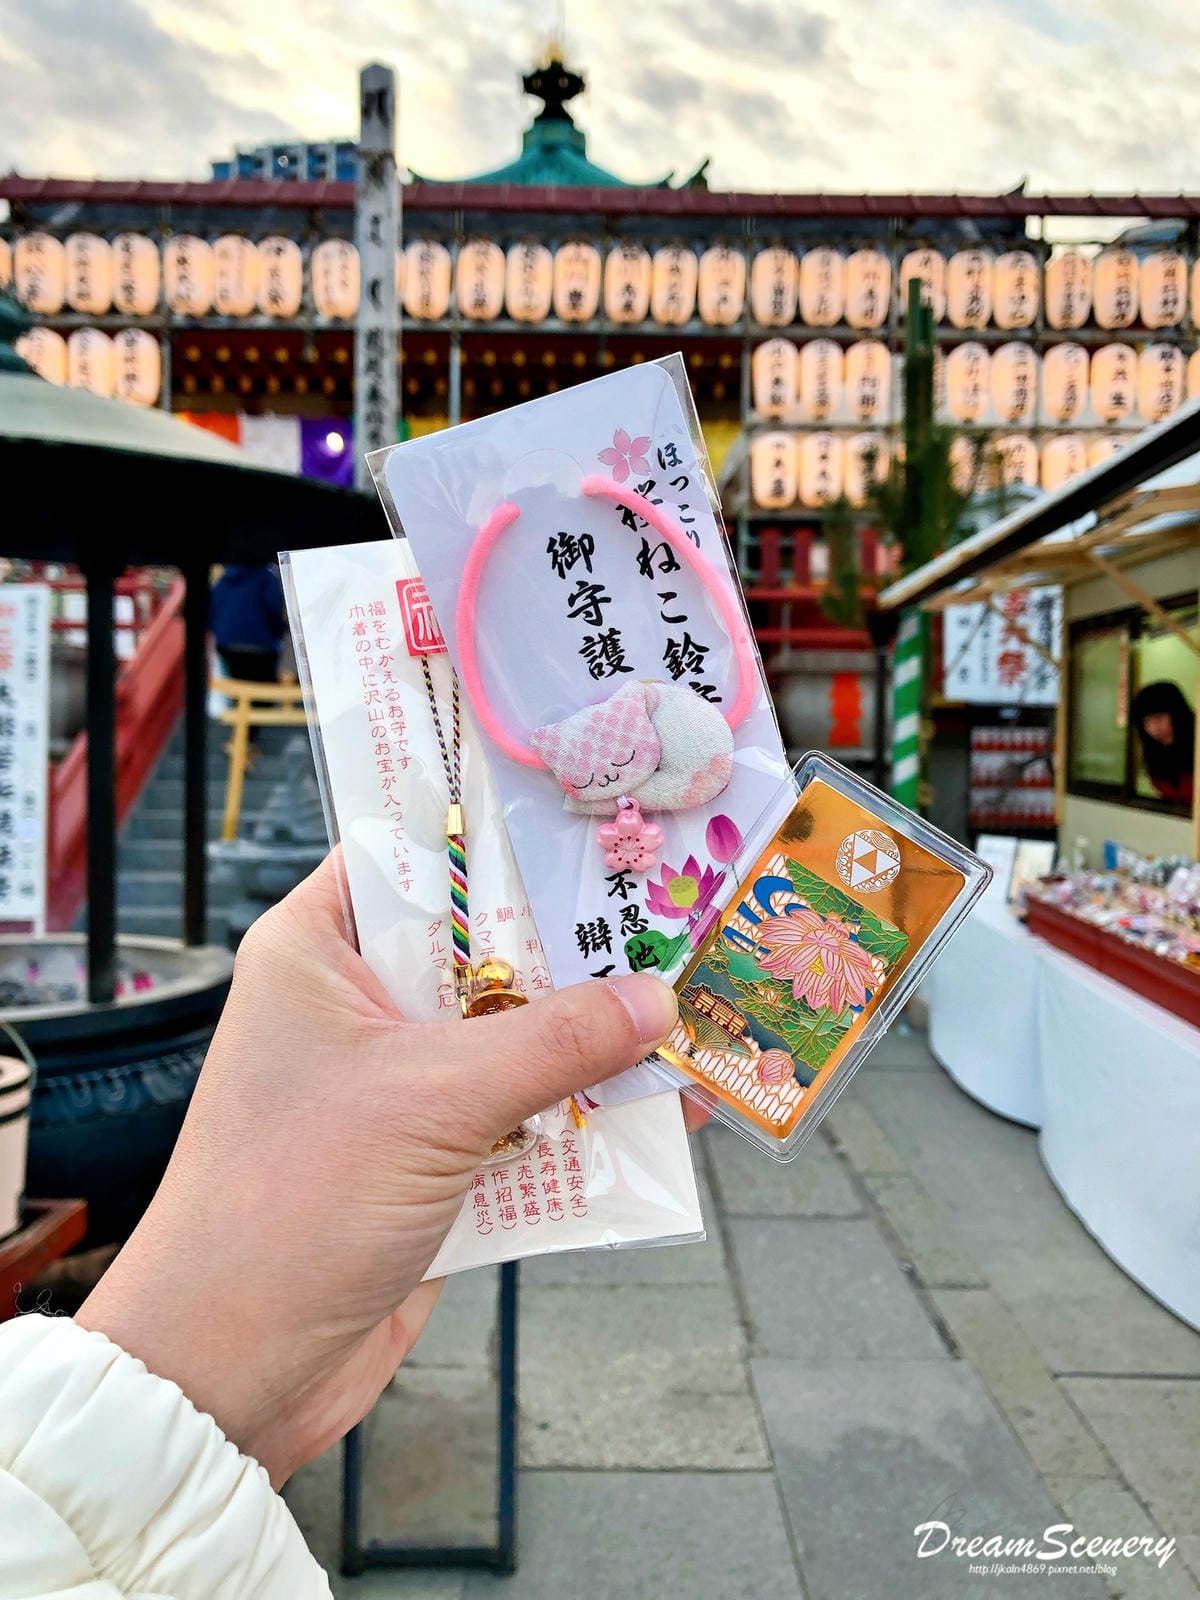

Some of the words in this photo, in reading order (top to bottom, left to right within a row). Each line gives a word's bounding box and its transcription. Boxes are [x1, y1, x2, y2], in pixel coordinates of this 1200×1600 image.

[657, 442, 701, 549] ほっこり
[546, 531, 635, 681] 御守護
[367, 600, 413, 770] 福をむかえるお守です
[349, 603, 415, 893] 巾着の中に沢山のお宝が入っています
[574, 916, 616, 978] 辯
[604, 868, 660, 972] 不忍池
[516, 1155, 541, 1226] 売繁盛）
